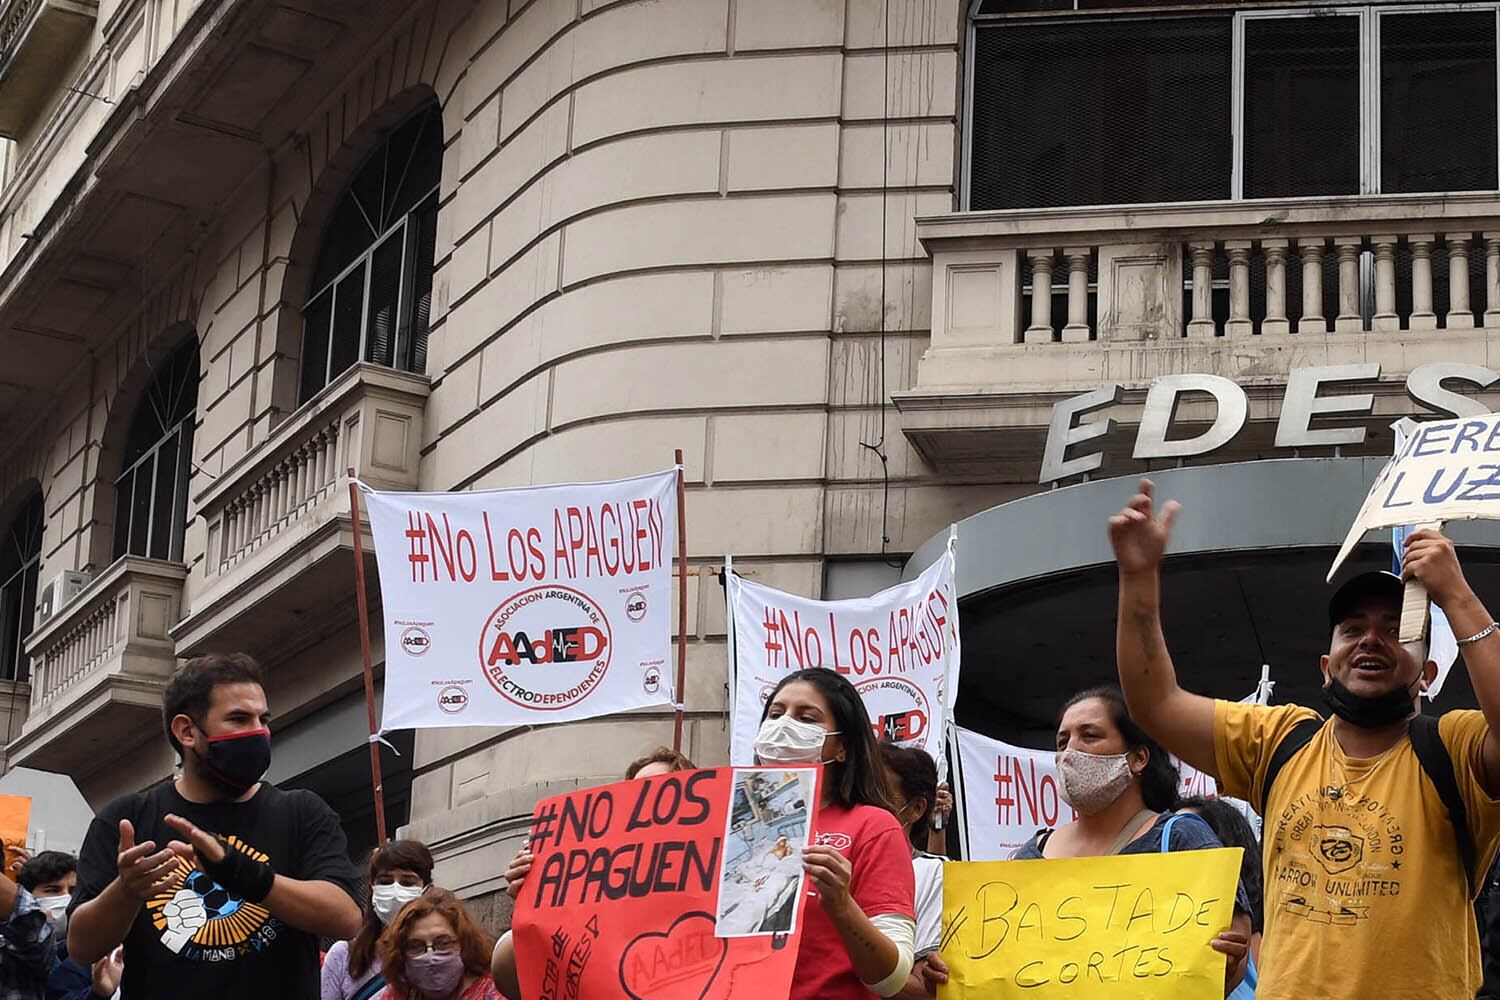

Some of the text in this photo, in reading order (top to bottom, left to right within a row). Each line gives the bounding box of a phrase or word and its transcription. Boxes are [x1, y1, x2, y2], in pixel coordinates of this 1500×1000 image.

[554, 497, 663, 580] APAGUEN
[494, 591, 600, 630] ASOCIACION ARGENTINA DE
[490, 660, 605, 704] ELECTRODEPENDIENTES
[880, 681, 917, 699] ARGENTINA
[528, 770, 717, 853] #NO LOS
[534, 837, 721, 908] APAGUEN
[1275, 865, 1400, 897] ARROW UNLIMITED
[202, 947, 235, 962] MANO
[1015, 945, 1173, 988] CORTES
